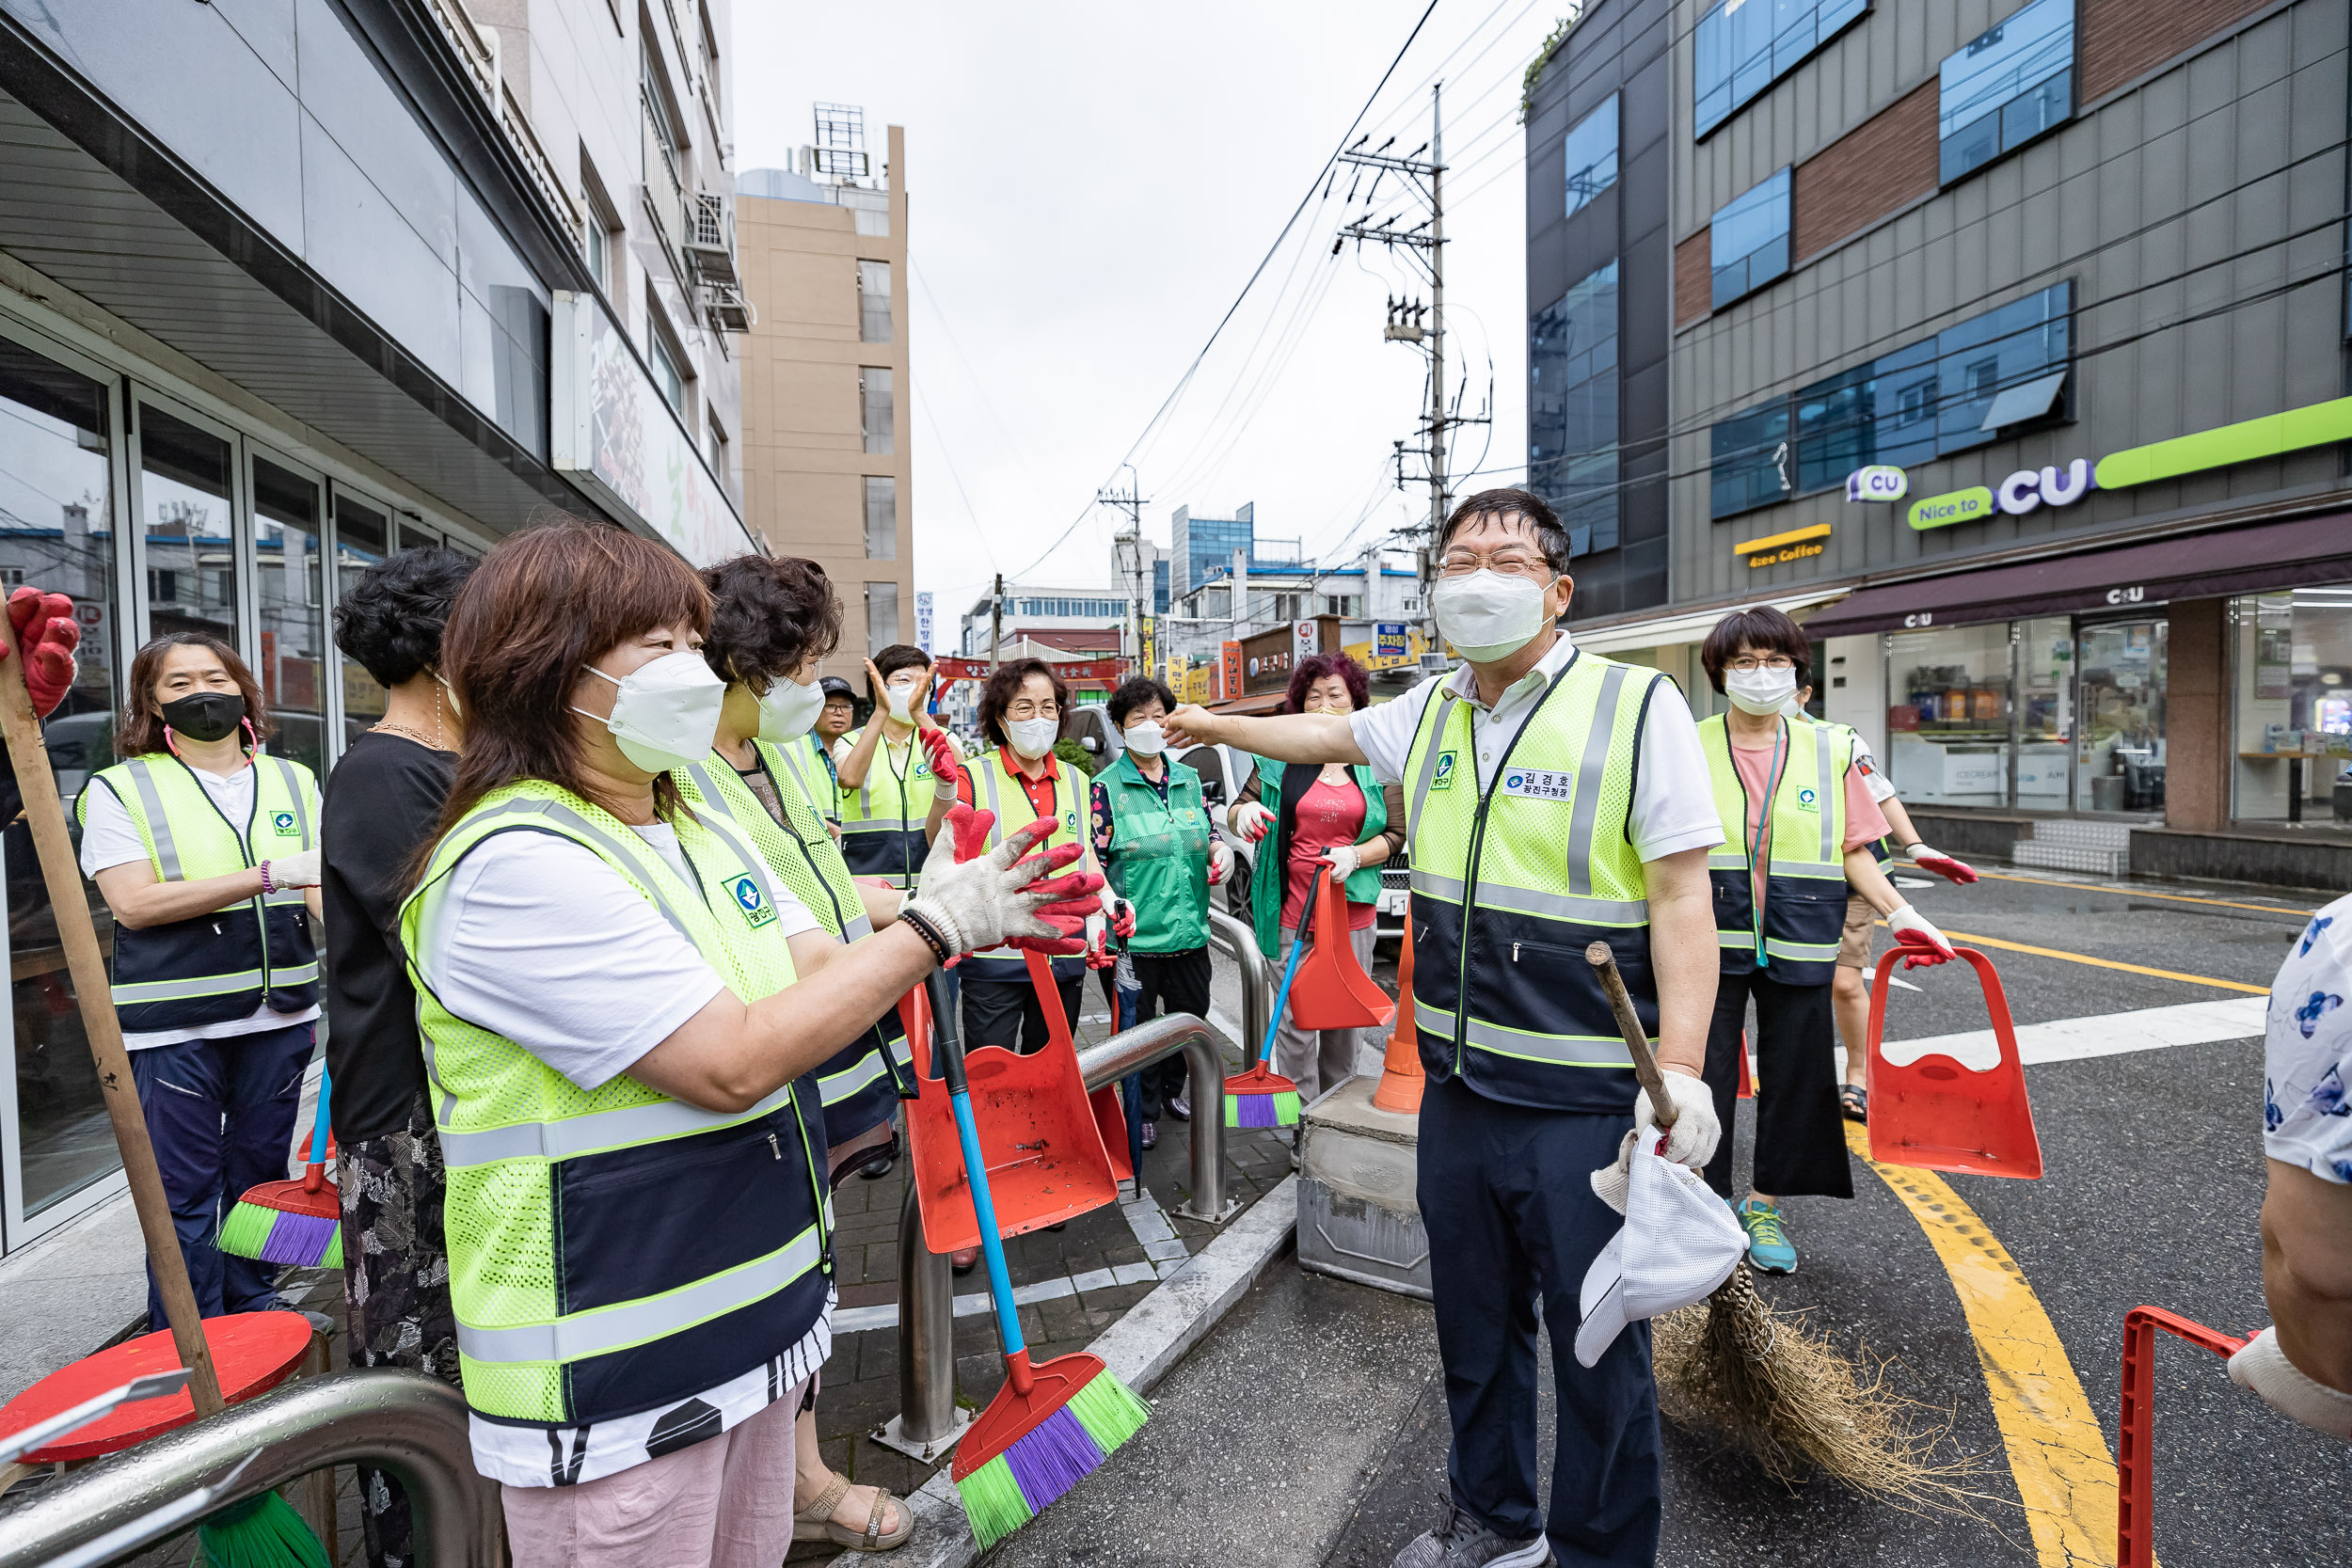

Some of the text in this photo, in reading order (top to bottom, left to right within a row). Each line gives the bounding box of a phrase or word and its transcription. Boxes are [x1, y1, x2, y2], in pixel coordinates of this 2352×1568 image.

[1871, 475, 1898, 491] CU
[1919, 458, 2087, 522] Nice to CU
[1778, 545, 1823, 562] Coffee
[1378, 634, 1406, 648] 주차장
[1434, 778, 1449, 786] 광진구
[1524, 784, 1567, 798] 광진구청장
[748, 906, 771, 922] 광진구
